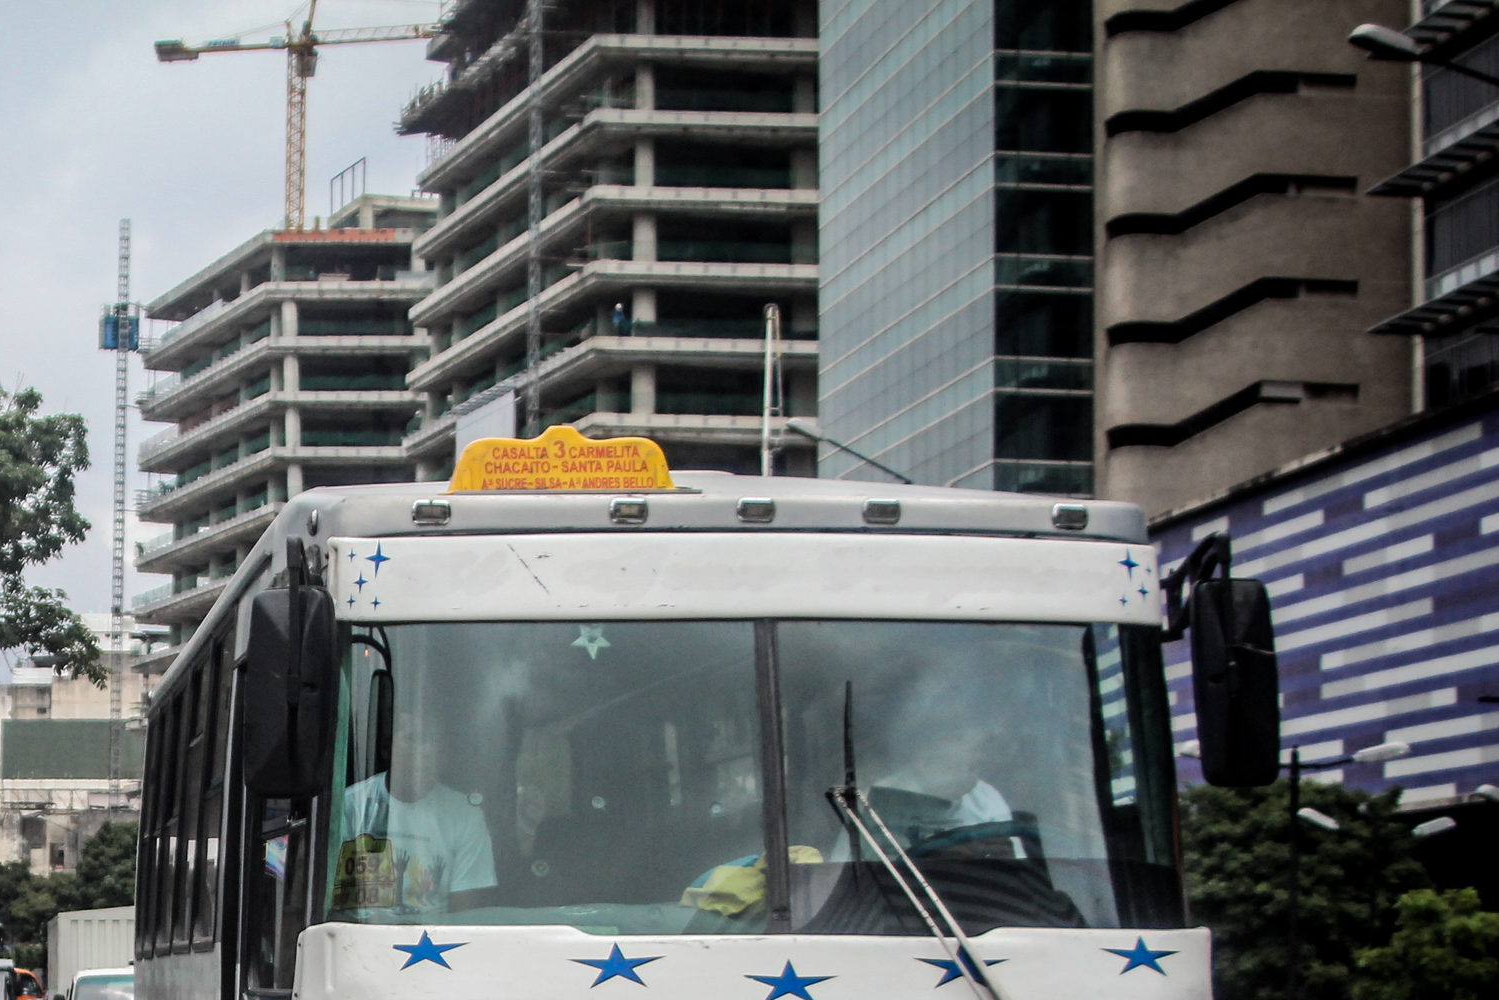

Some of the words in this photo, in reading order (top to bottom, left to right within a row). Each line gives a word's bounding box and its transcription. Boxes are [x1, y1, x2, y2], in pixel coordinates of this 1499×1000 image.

[492, 446, 549, 460] CASALTA
[553, 440, 566, 459] 3
[568, 445, 640, 459] CARMELITA
[484, 461, 550, 474] CHACAITO
[561, 460, 602, 473] SANTA
[606, 459, 649, 473] PAULA
[582, 476, 620, 489] ANDRES
[623, 476, 654, 489] BELLO
[344, 856, 381, 876] 059
